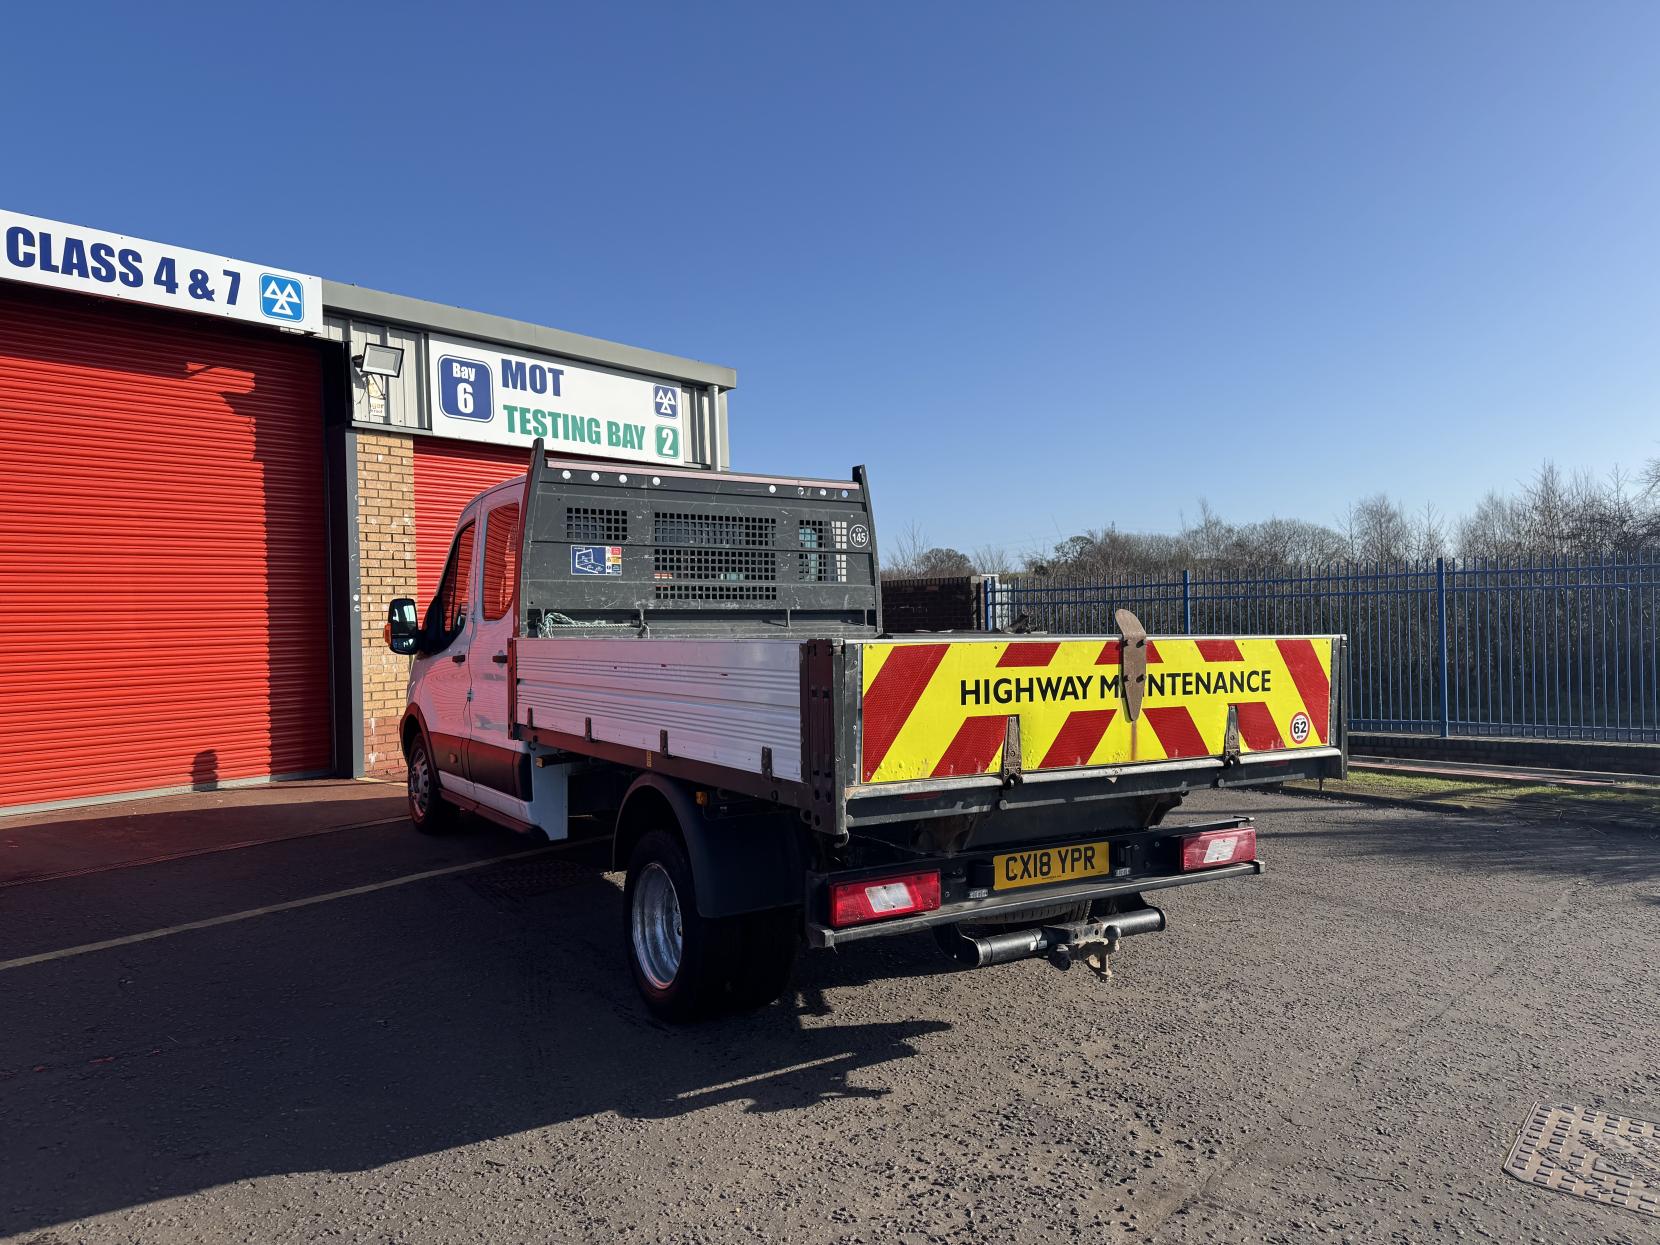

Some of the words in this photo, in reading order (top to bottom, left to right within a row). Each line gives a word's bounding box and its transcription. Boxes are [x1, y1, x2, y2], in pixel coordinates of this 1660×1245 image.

[6, 226, 144, 288] CLASS
[153, 256, 179, 294] 4
[188, 268, 215, 302] &
[222, 269, 241, 305] 7
[452, 362, 476, 381] Bay
[501, 358, 564, 397] MOT
[457, 382, 474, 414] 6
[503, 404, 601, 445] TESTING
[607, 420, 646, 450] BAY
[661, 428, 674, 455] 2
[852, 532, 866, 543] 145
[961, 675, 1093, 705] HIGHWAY
[1100, 670, 1271, 699] MNTENANCE
[1293, 721, 1307, 734] 62
[1005, 851, 1052, 882] CX18
[1058, 846, 1096, 874] YPR
